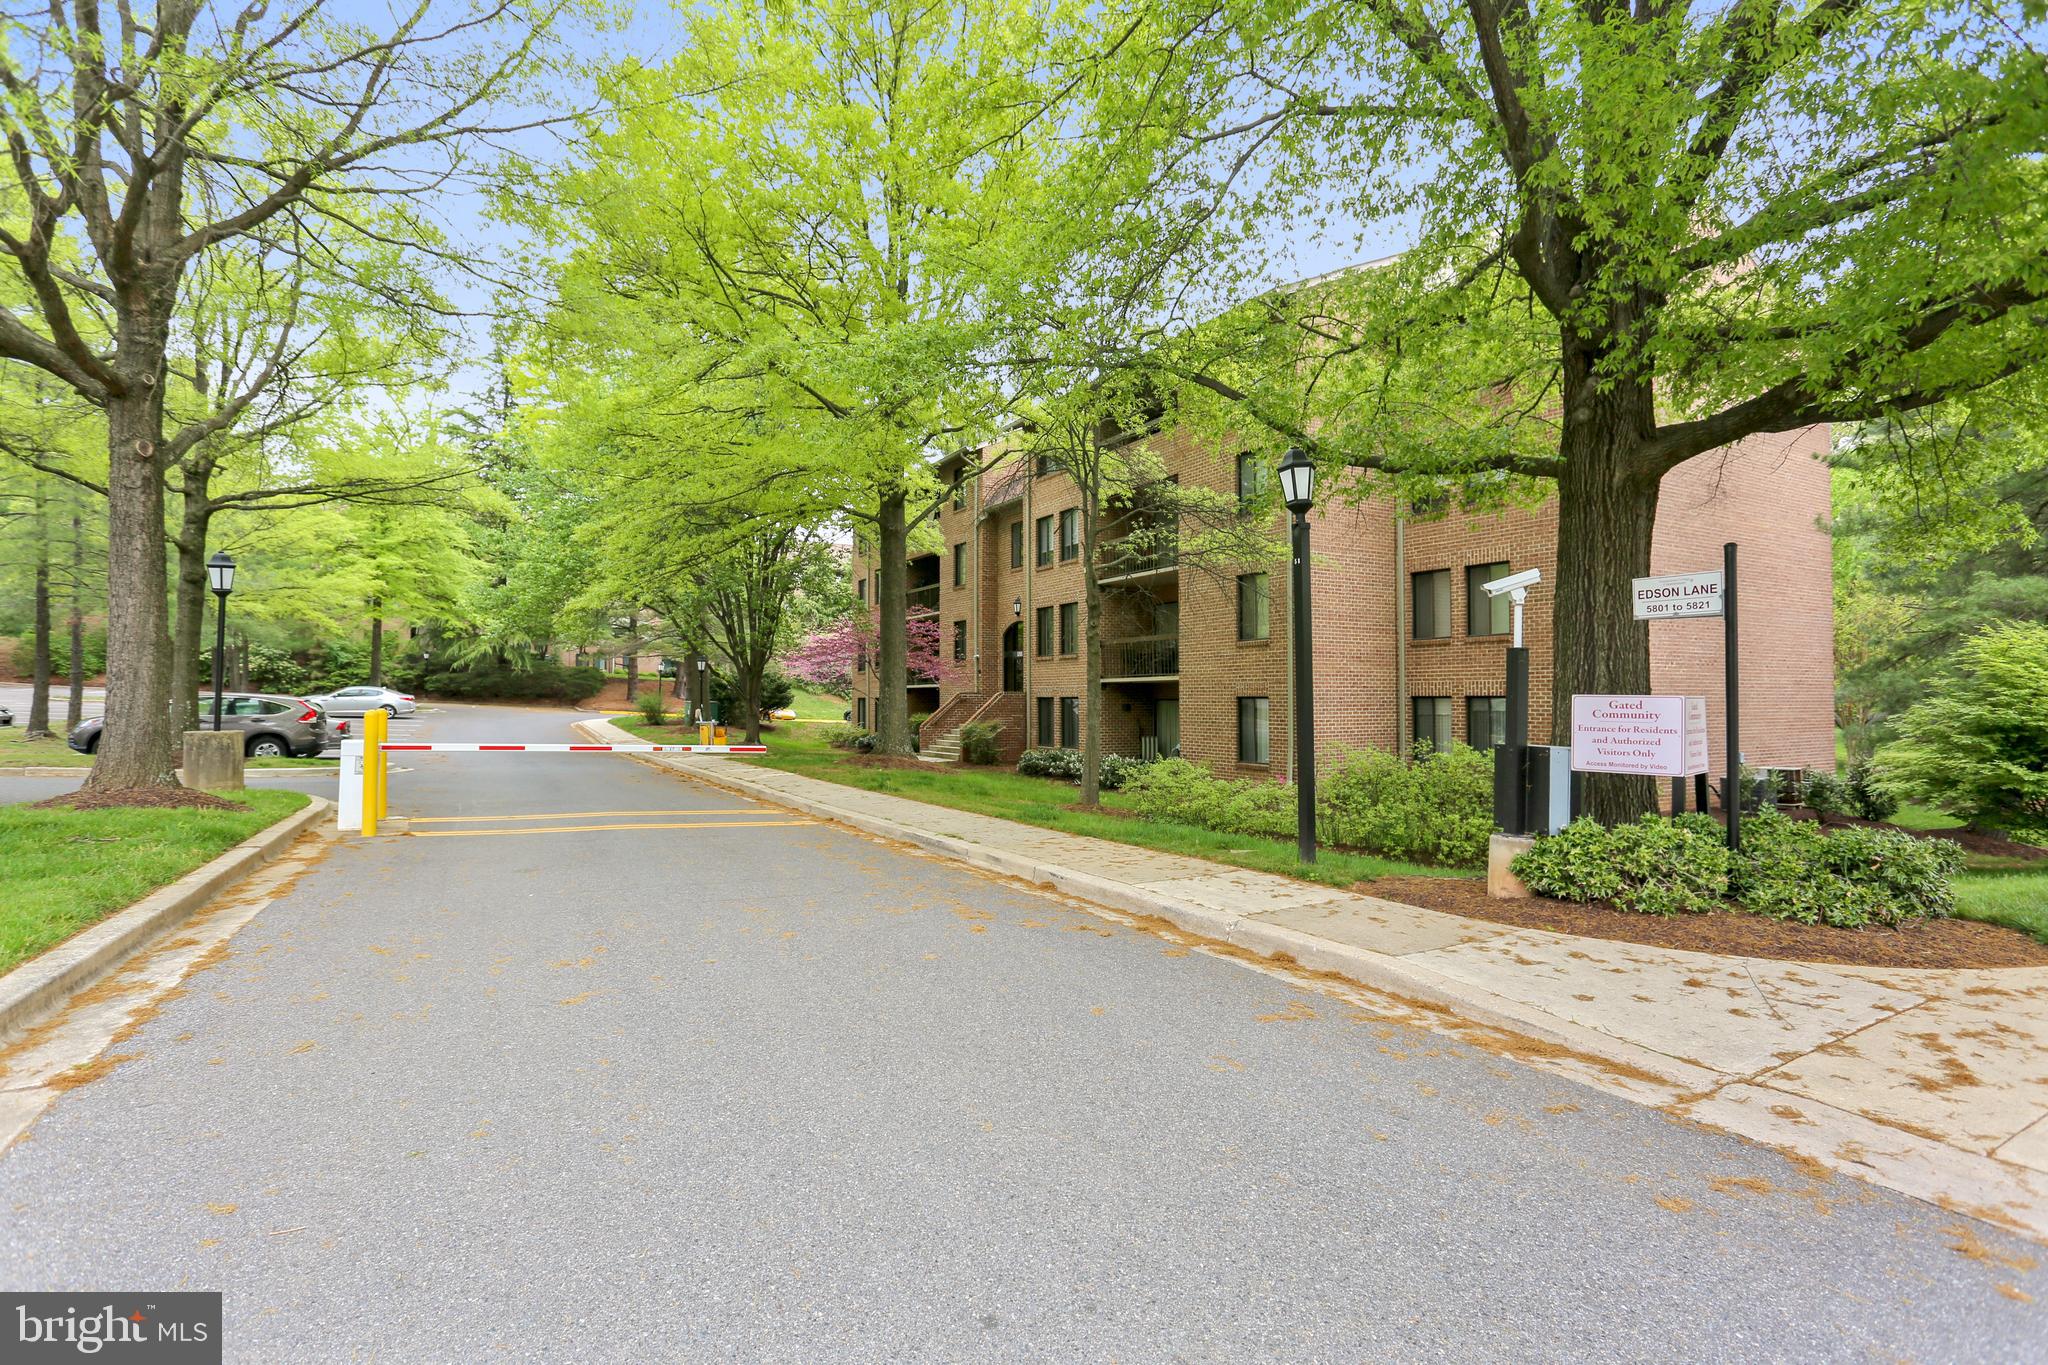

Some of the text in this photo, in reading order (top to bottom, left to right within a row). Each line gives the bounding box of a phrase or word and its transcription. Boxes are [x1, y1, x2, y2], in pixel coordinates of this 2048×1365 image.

[1637, 583, 1718, 600] EDSON LANE
[1646, 604, 1669, 613] 5801
[1686, 601, 1710, 610] 5821
[1608, 700, 1643, 710] Gated
[1592, 709, 1661, 722] Community
[1578, 724, 1616, 733] Entrance
[1618, 725, 1631, 733] for
[1633, 725, 1678, 735] Residents
[1592, 736, 1661, 746] and Authorized
[1597, 747, 1656, 760] Visitors Only
[1608, 761, 1639, 769] Monitored
[1640, 762, 1648, 770] by
[1650, 762, 1668, 770] Video
